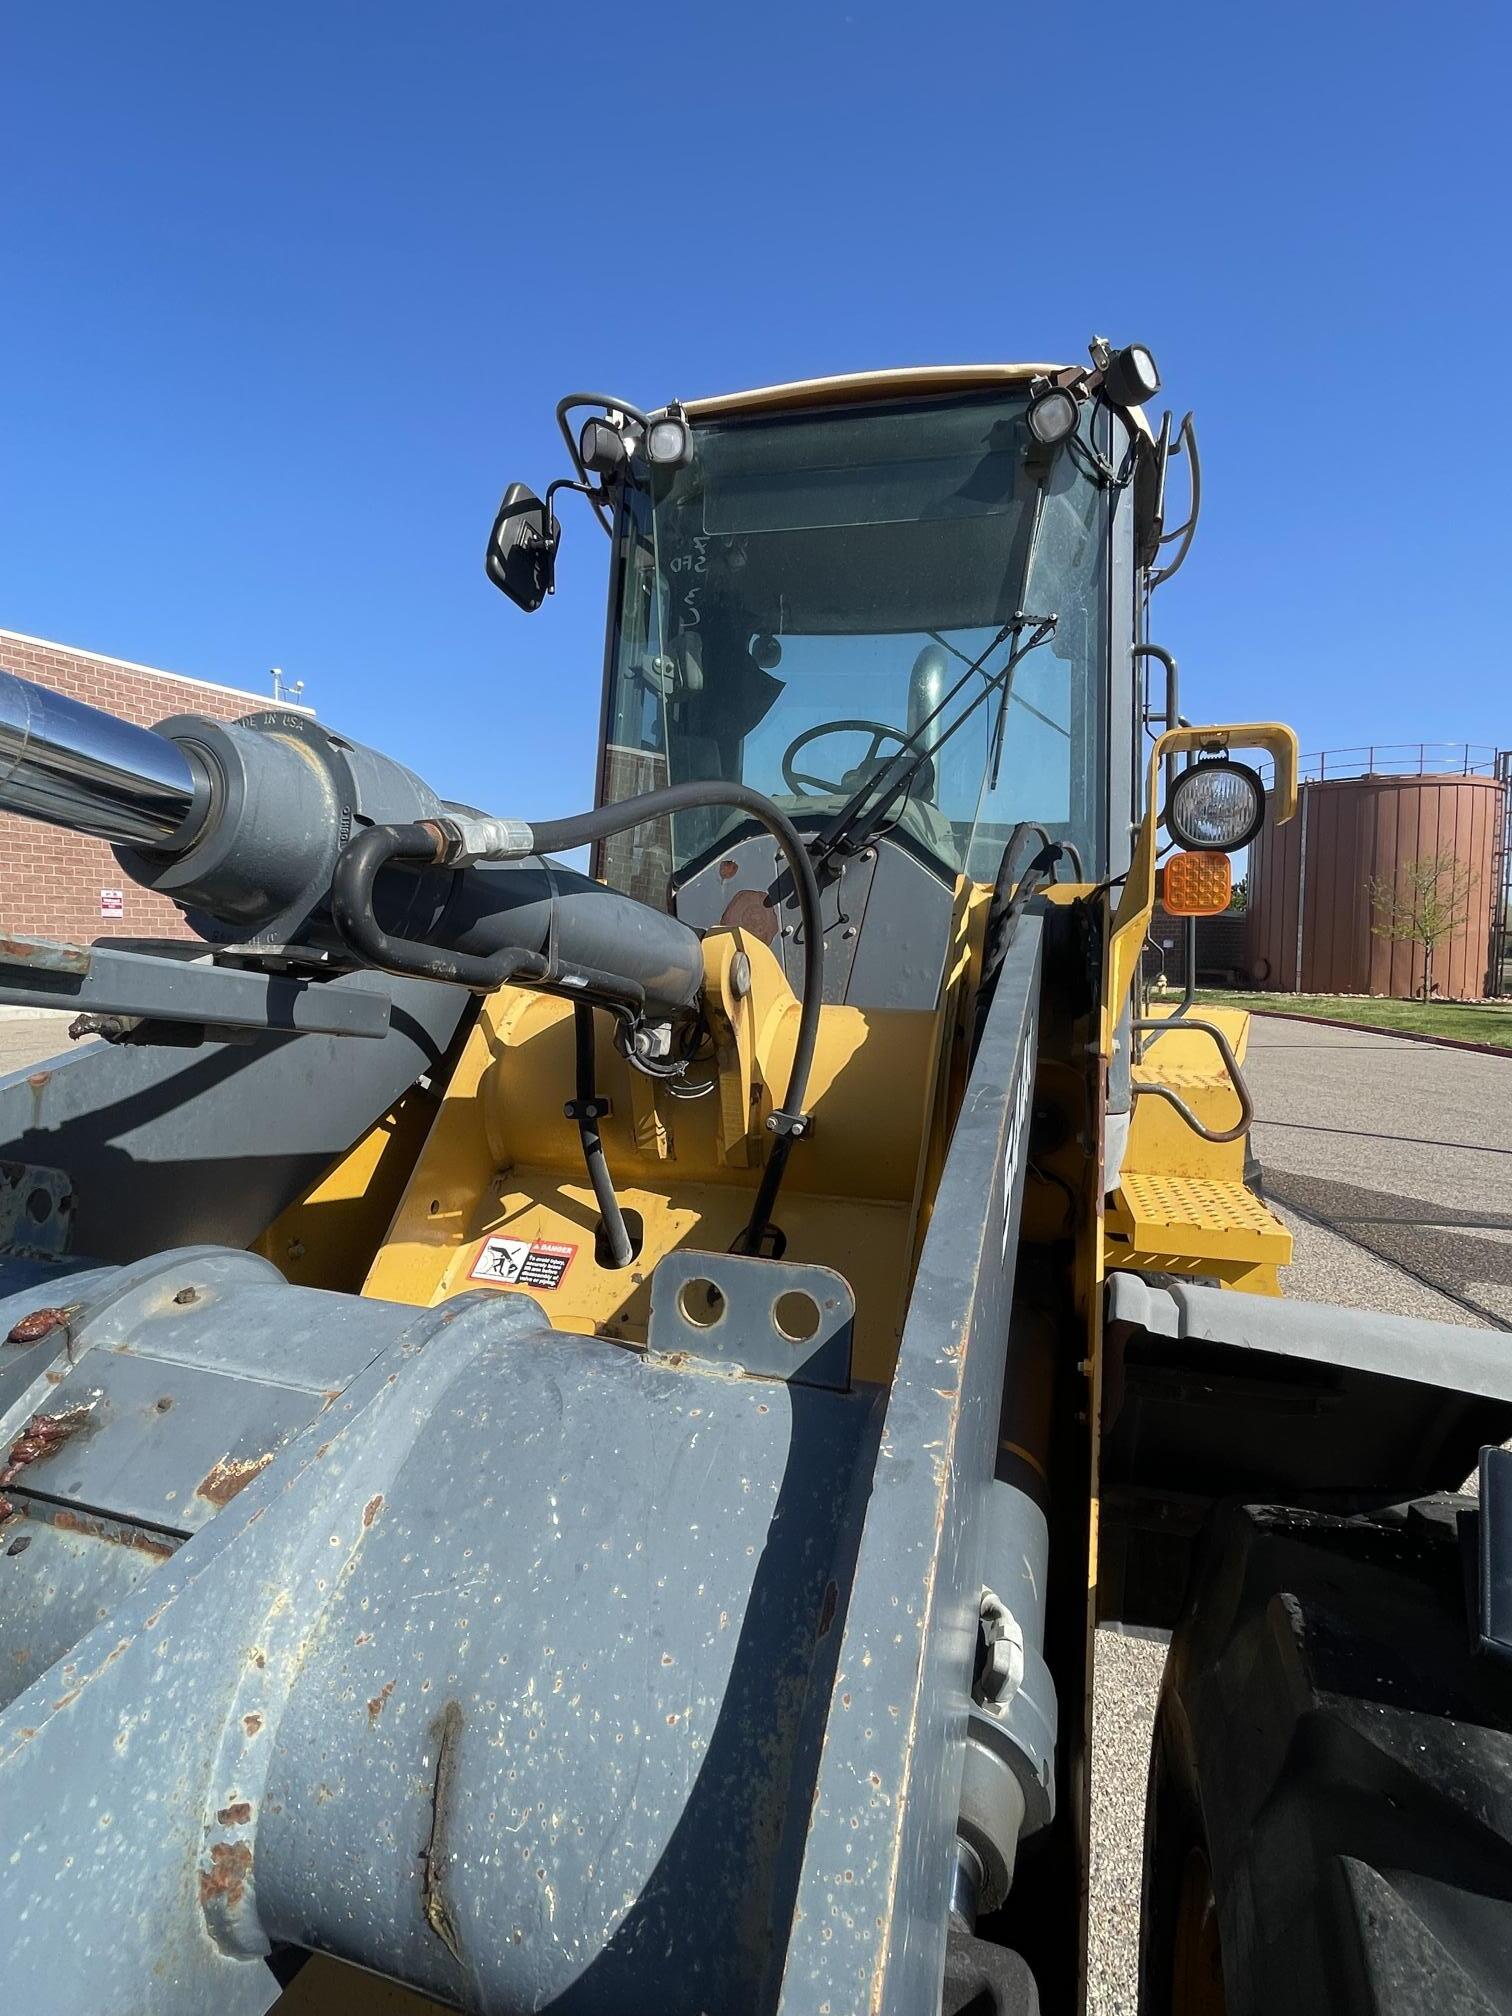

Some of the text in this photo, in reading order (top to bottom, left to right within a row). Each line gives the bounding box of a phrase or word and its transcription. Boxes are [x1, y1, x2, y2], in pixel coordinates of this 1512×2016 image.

[264, 713, 278, 725] IN
[282, 715, 304, 731] USA
[540, 1244, 573, 1254] DANGER
